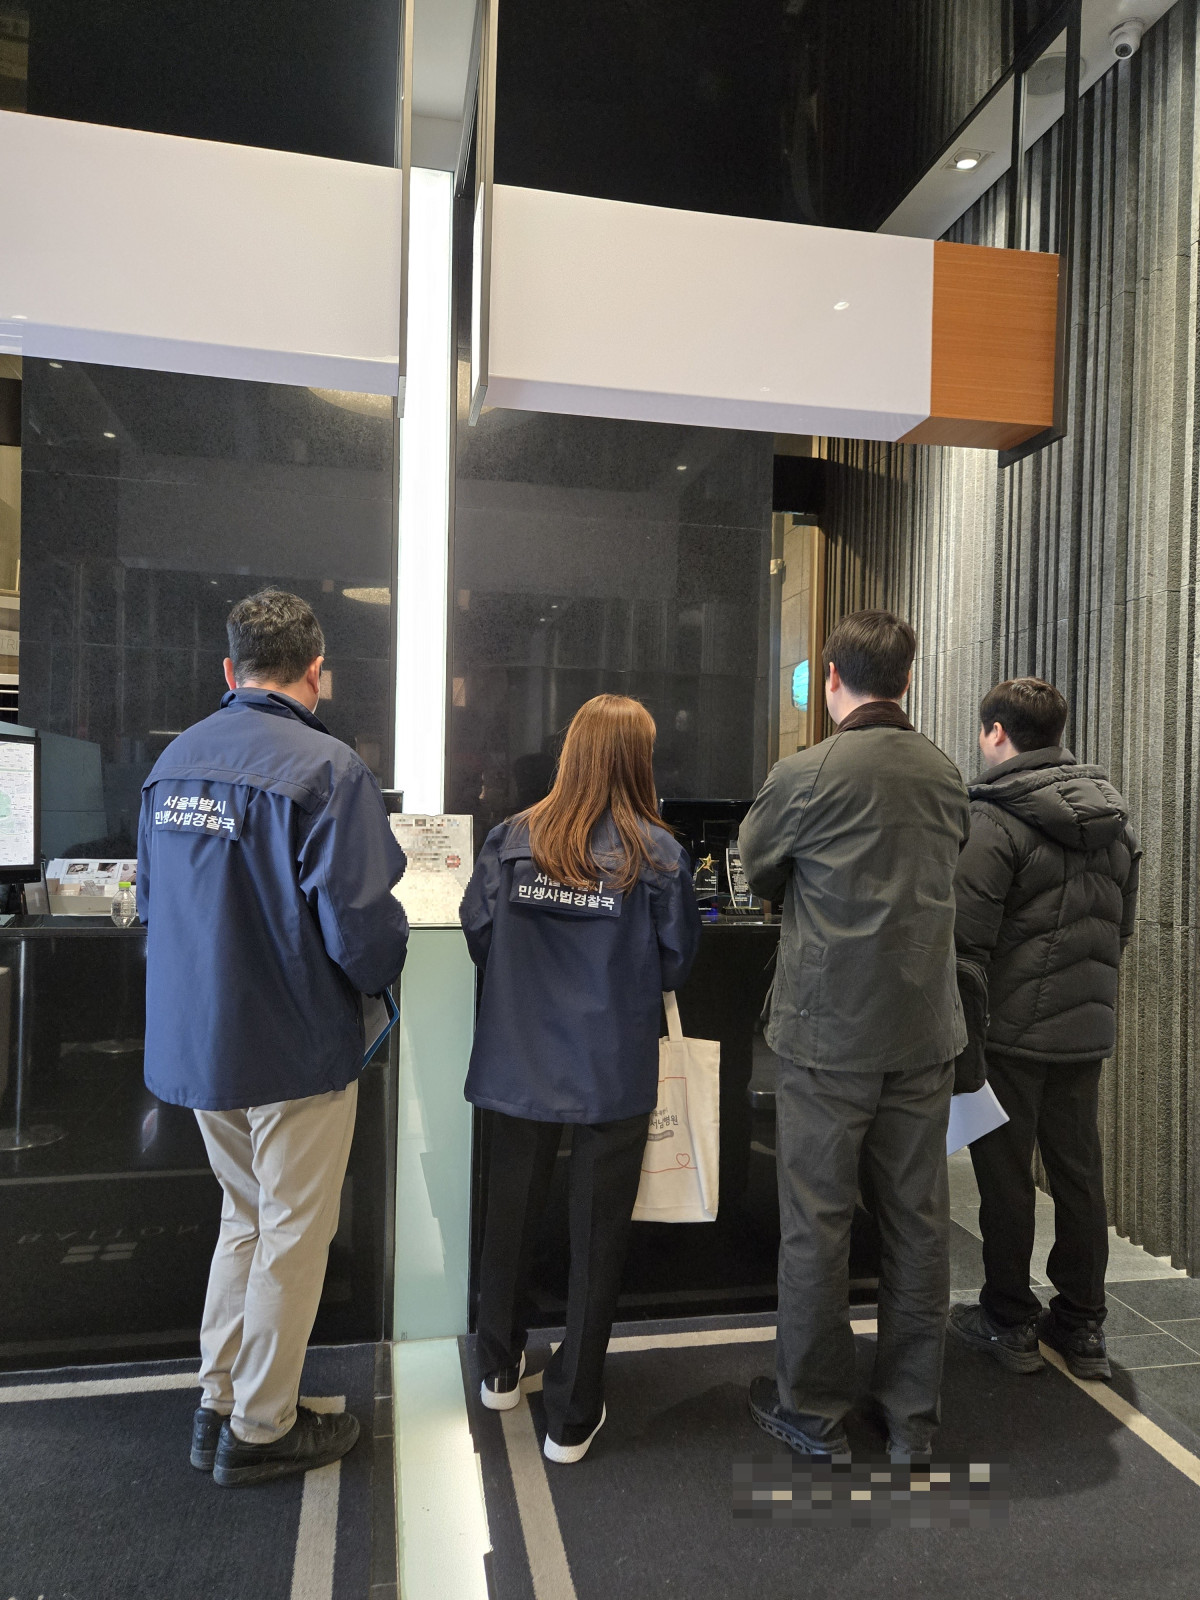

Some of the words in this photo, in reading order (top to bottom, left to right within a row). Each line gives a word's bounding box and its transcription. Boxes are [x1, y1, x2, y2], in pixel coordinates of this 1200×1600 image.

[163, 796, 226, 815] 서울특별시
[155, 810, 235, 832] 민생사법경찰국
[518, 884, 615, 911] 민생사법경찰국
